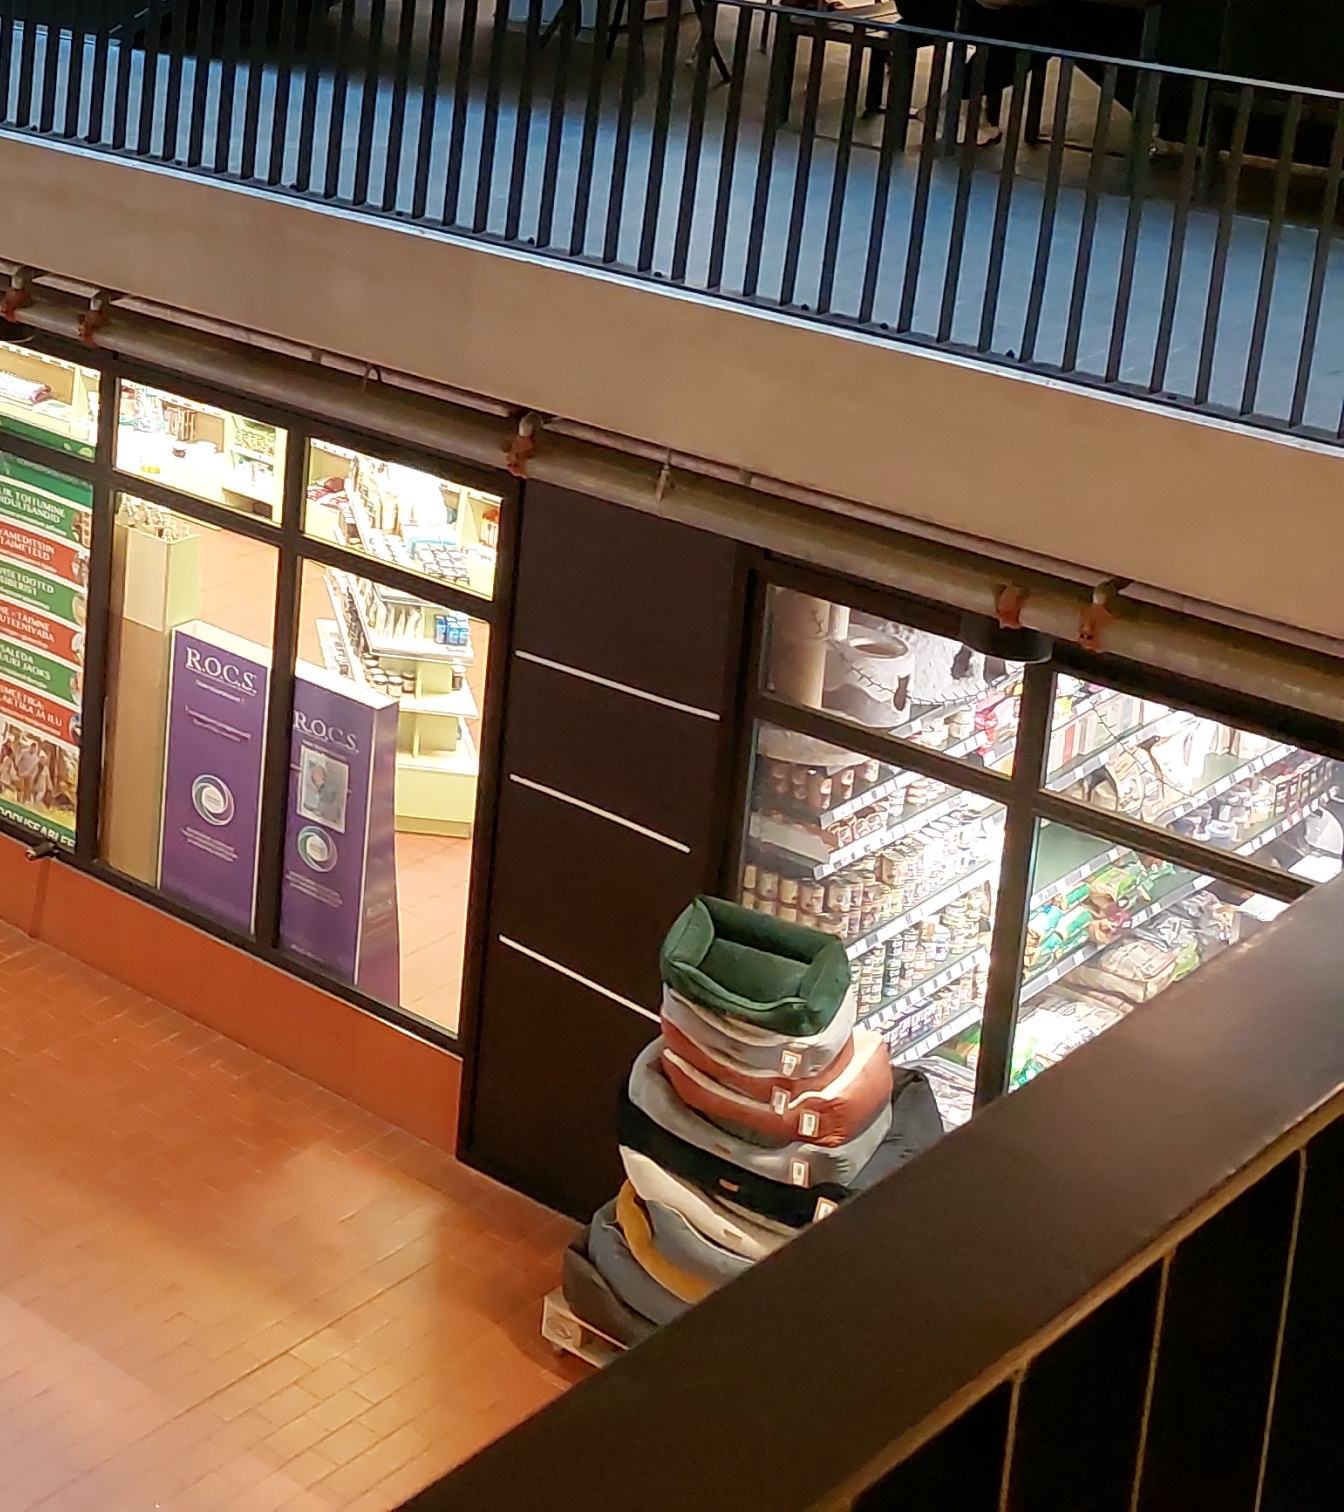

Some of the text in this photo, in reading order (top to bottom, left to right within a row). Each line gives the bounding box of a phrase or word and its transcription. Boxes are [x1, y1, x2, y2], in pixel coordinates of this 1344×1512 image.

[15, 491, 66, 518] TOITUMINE
[0, 644, 33, 664] SALEDA
[185, 647, 257, 694] R.O.C.S.
